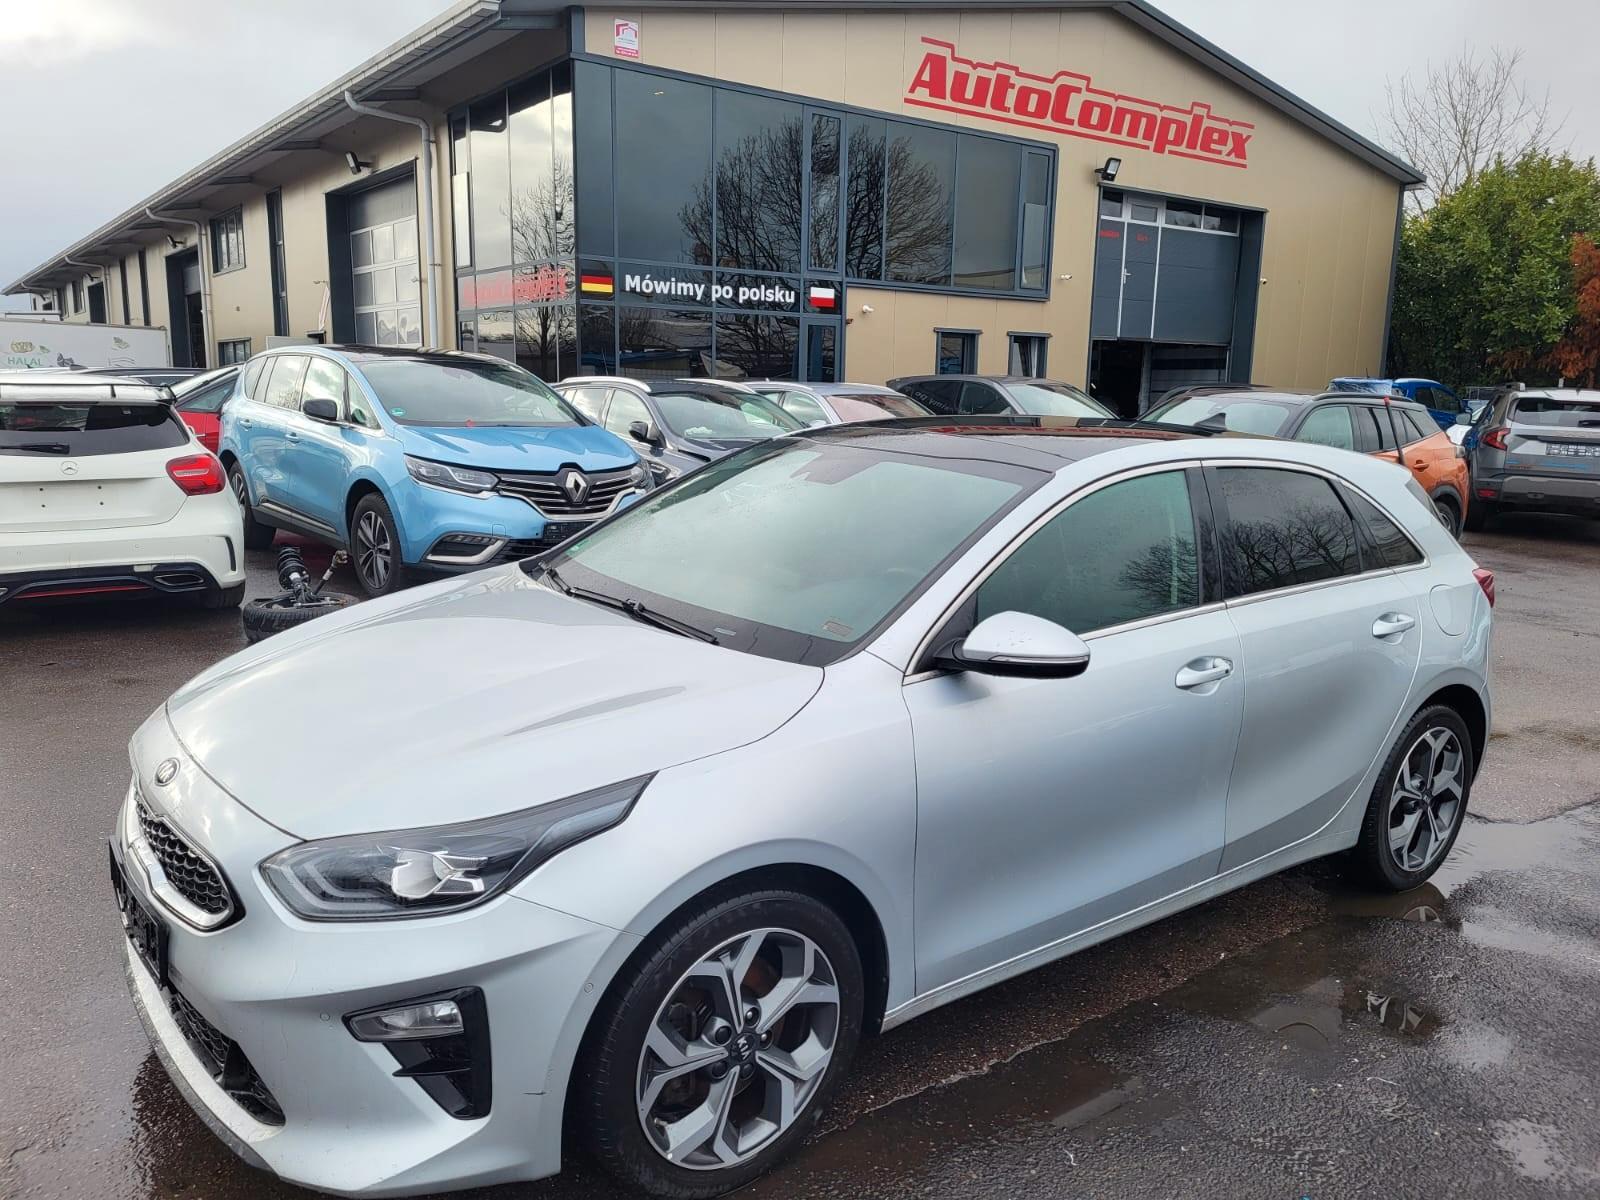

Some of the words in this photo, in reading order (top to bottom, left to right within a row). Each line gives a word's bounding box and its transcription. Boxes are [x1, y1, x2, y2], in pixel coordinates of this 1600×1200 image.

[908, 52, 1253, 160] AutoComplex
[625, 274, 705, 301] Mówimy
[711, 285, 733, 301] po
[739, 284, 795, 303] polsku
